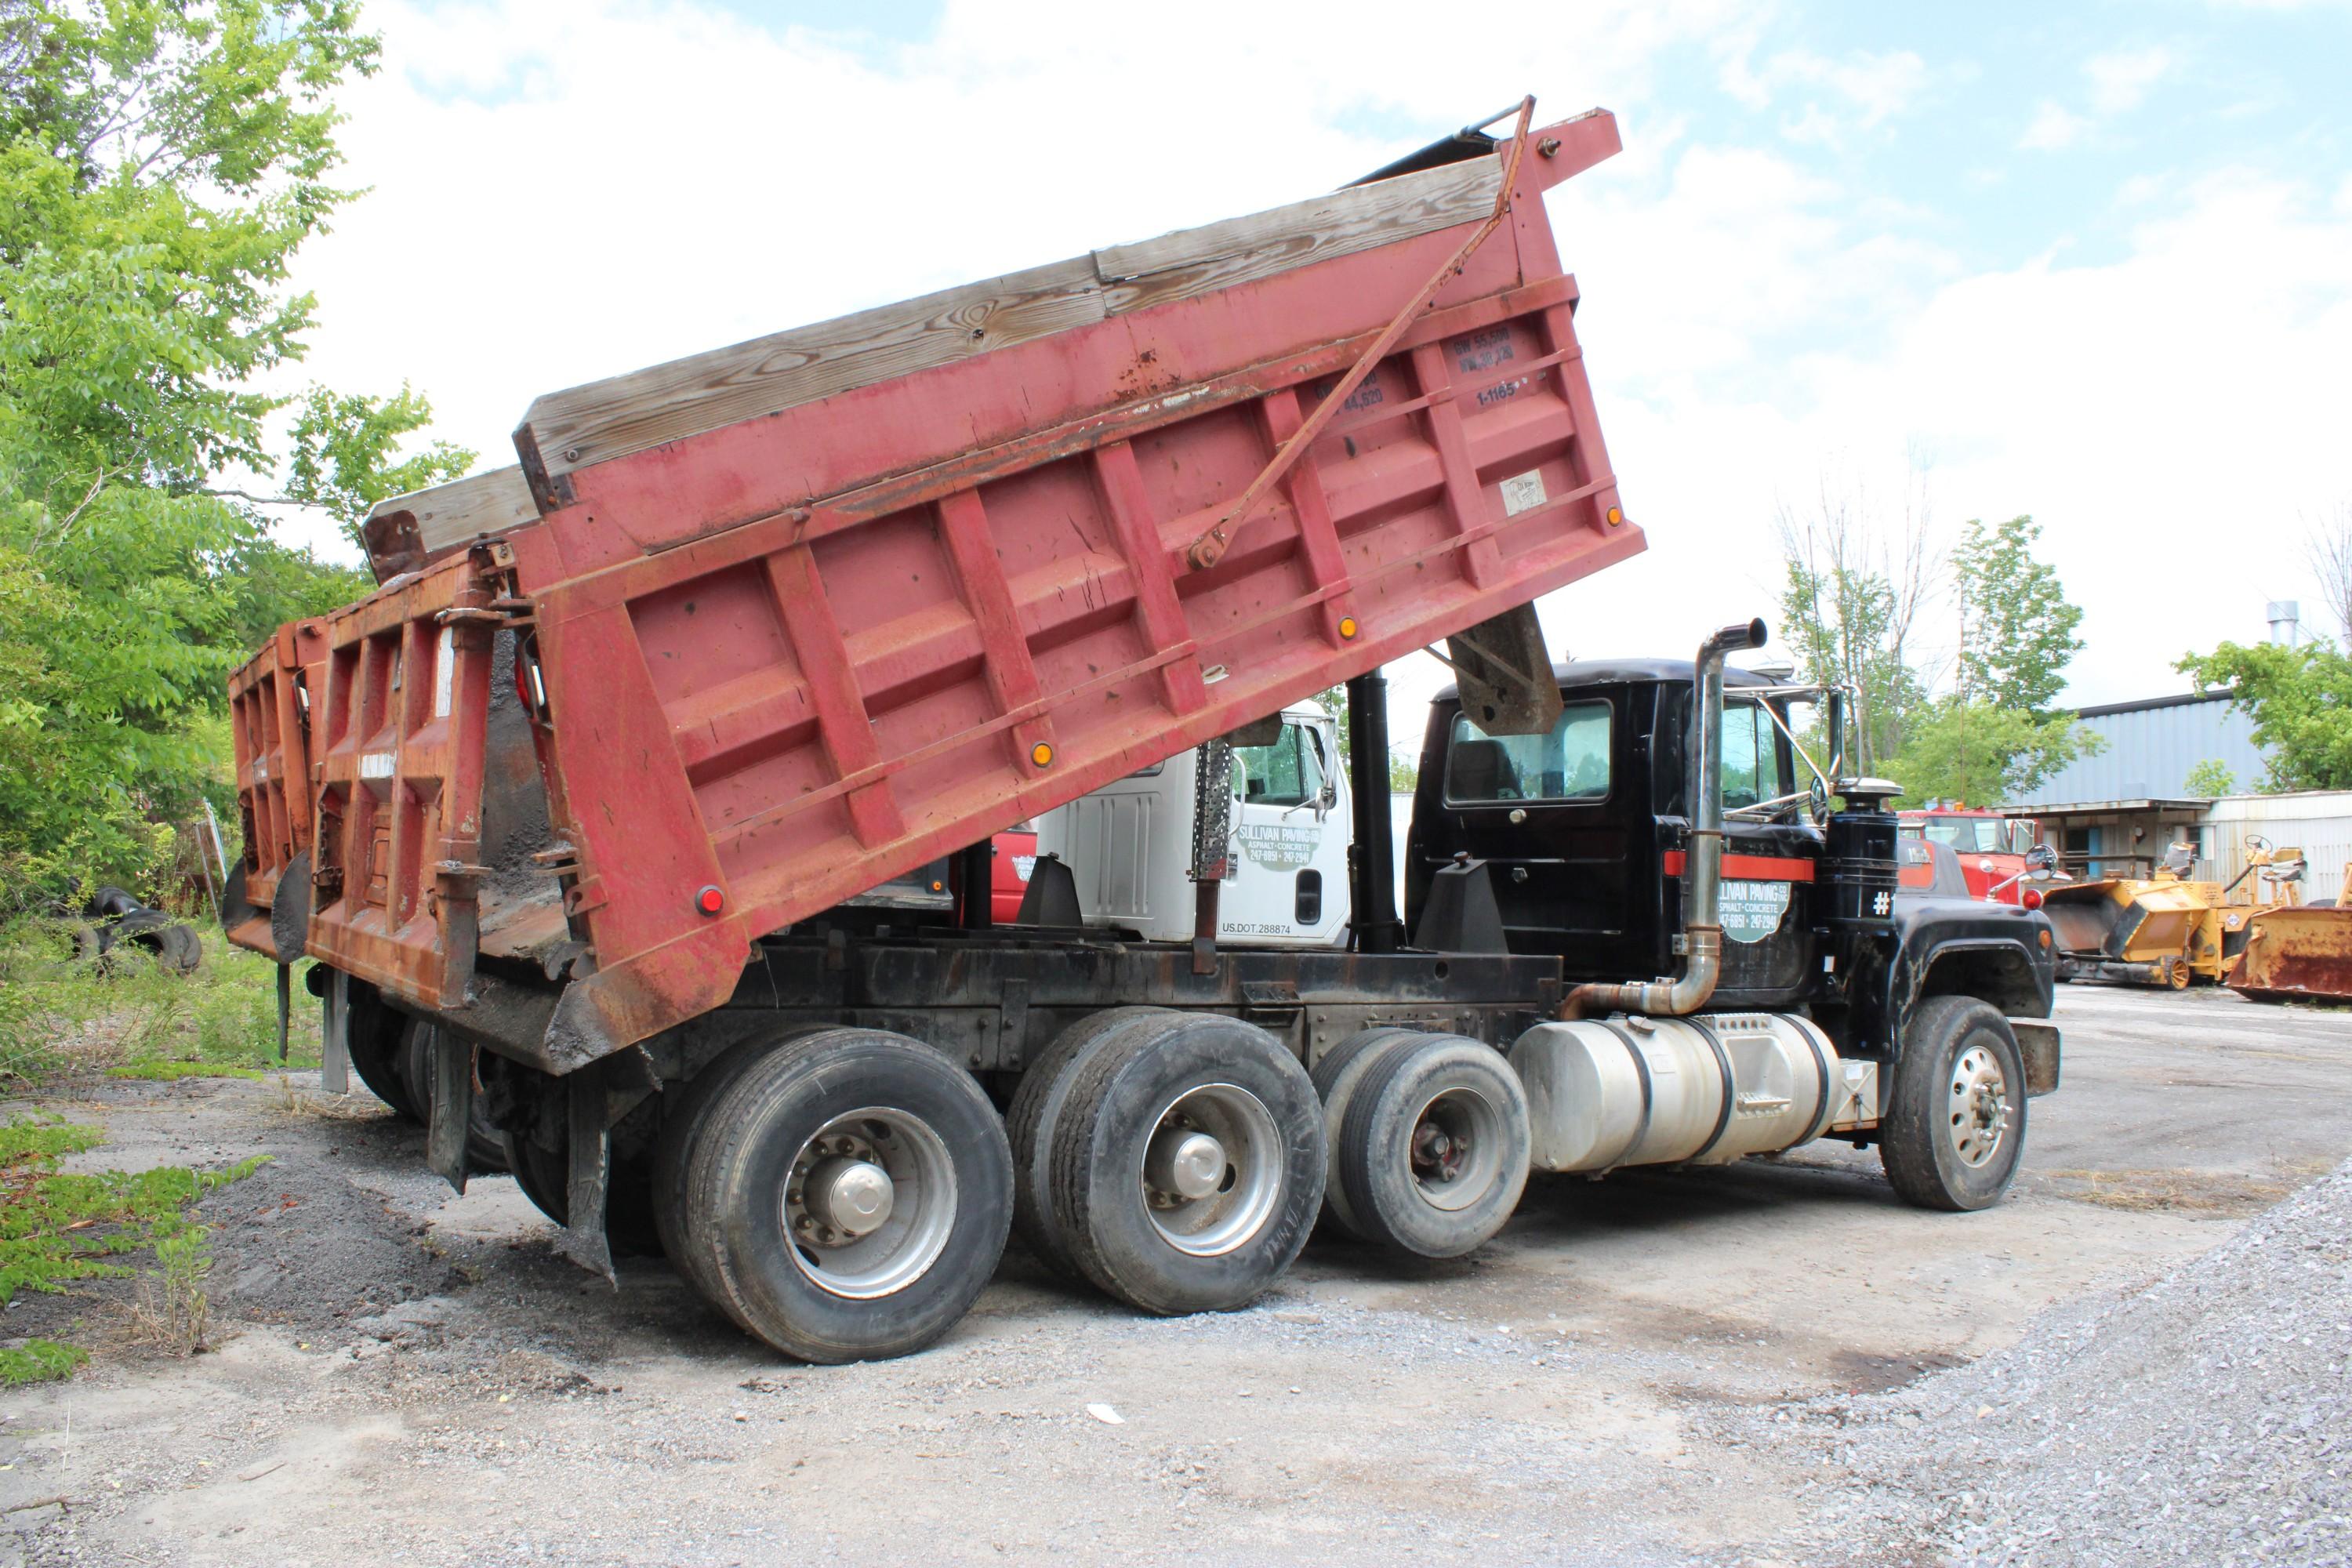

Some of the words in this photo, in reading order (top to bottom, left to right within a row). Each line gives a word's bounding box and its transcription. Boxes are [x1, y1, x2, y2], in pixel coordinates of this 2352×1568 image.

[1476, 382, 1515, 405] 1-1165
[1240, 826, 1279, 841] SULLIVAN
[1282, 828, 1309, 843] PAVING
[1248, 840, 1274, 849] ASPHALT
[1277, 843, 1310, 851] CONCRETE
[1750, 883, 1778, 902] PAVING
[1719, 902, 1742, 912] SPHALT
[1744, 902, 1779, 913] CONCRETE
[1719, 913, 1744, 928] 47-6851
[1751, 914, 1777, 929] 247-2941
